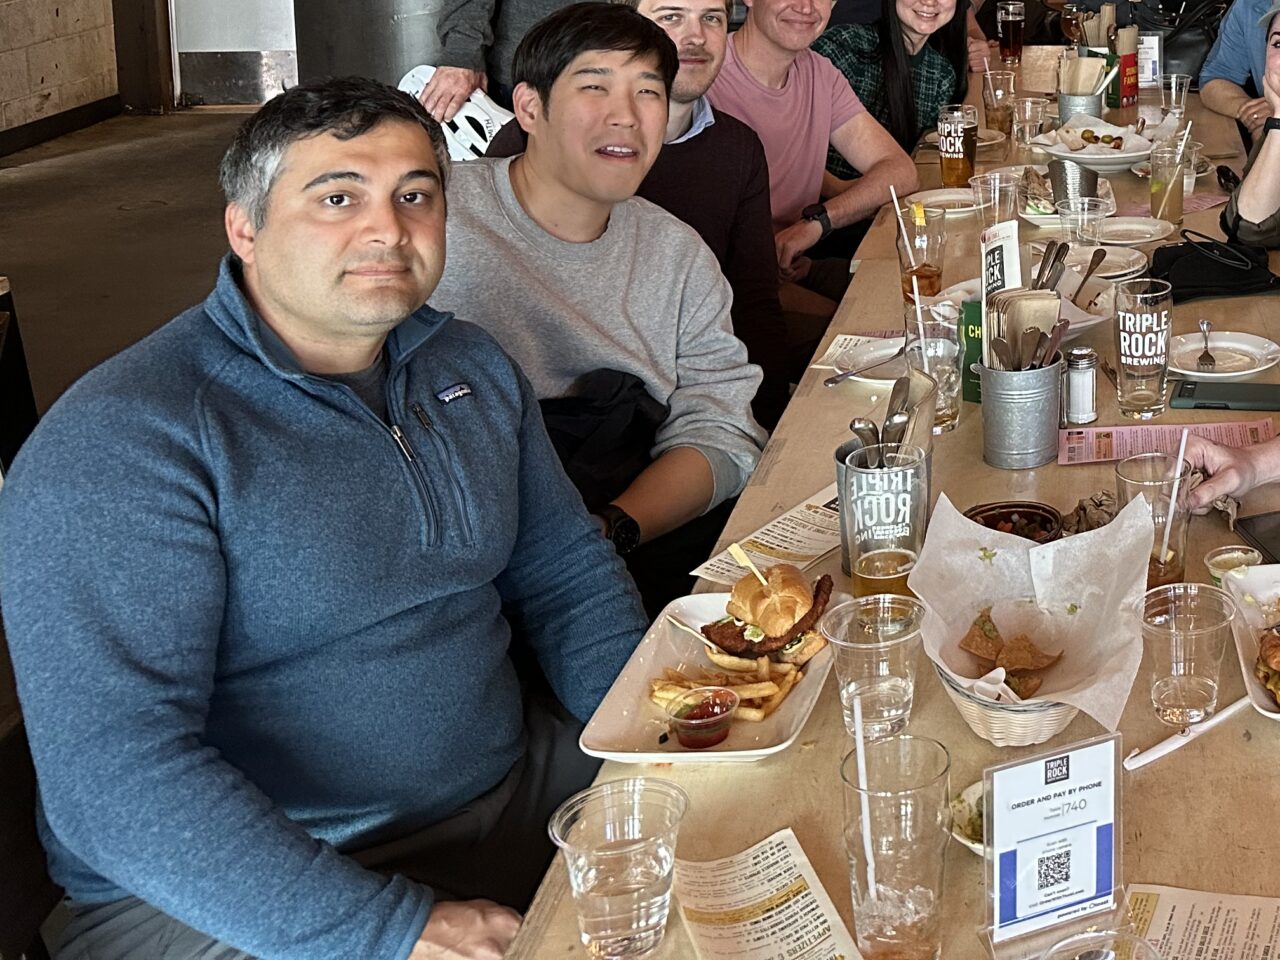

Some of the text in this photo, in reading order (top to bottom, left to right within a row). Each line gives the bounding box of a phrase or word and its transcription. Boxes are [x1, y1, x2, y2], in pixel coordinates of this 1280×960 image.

[940, 136, 964, 153] OCK
[1117, 310, 1169, 333] TRIPLE
[1120, 330, 1167, 357] ROCK
[1120, 355, 1166, 366] BREWING
[1046, 758, 1068, 770] TRIPLE
[1047, 765, 1067, 779] ROCK
[1011, 780, 1102, 811] ORDER AND PAY BY PHONE
[1064, 798, 1087, 814] 740
[786, 924, 832, 957] APPETIZERS
